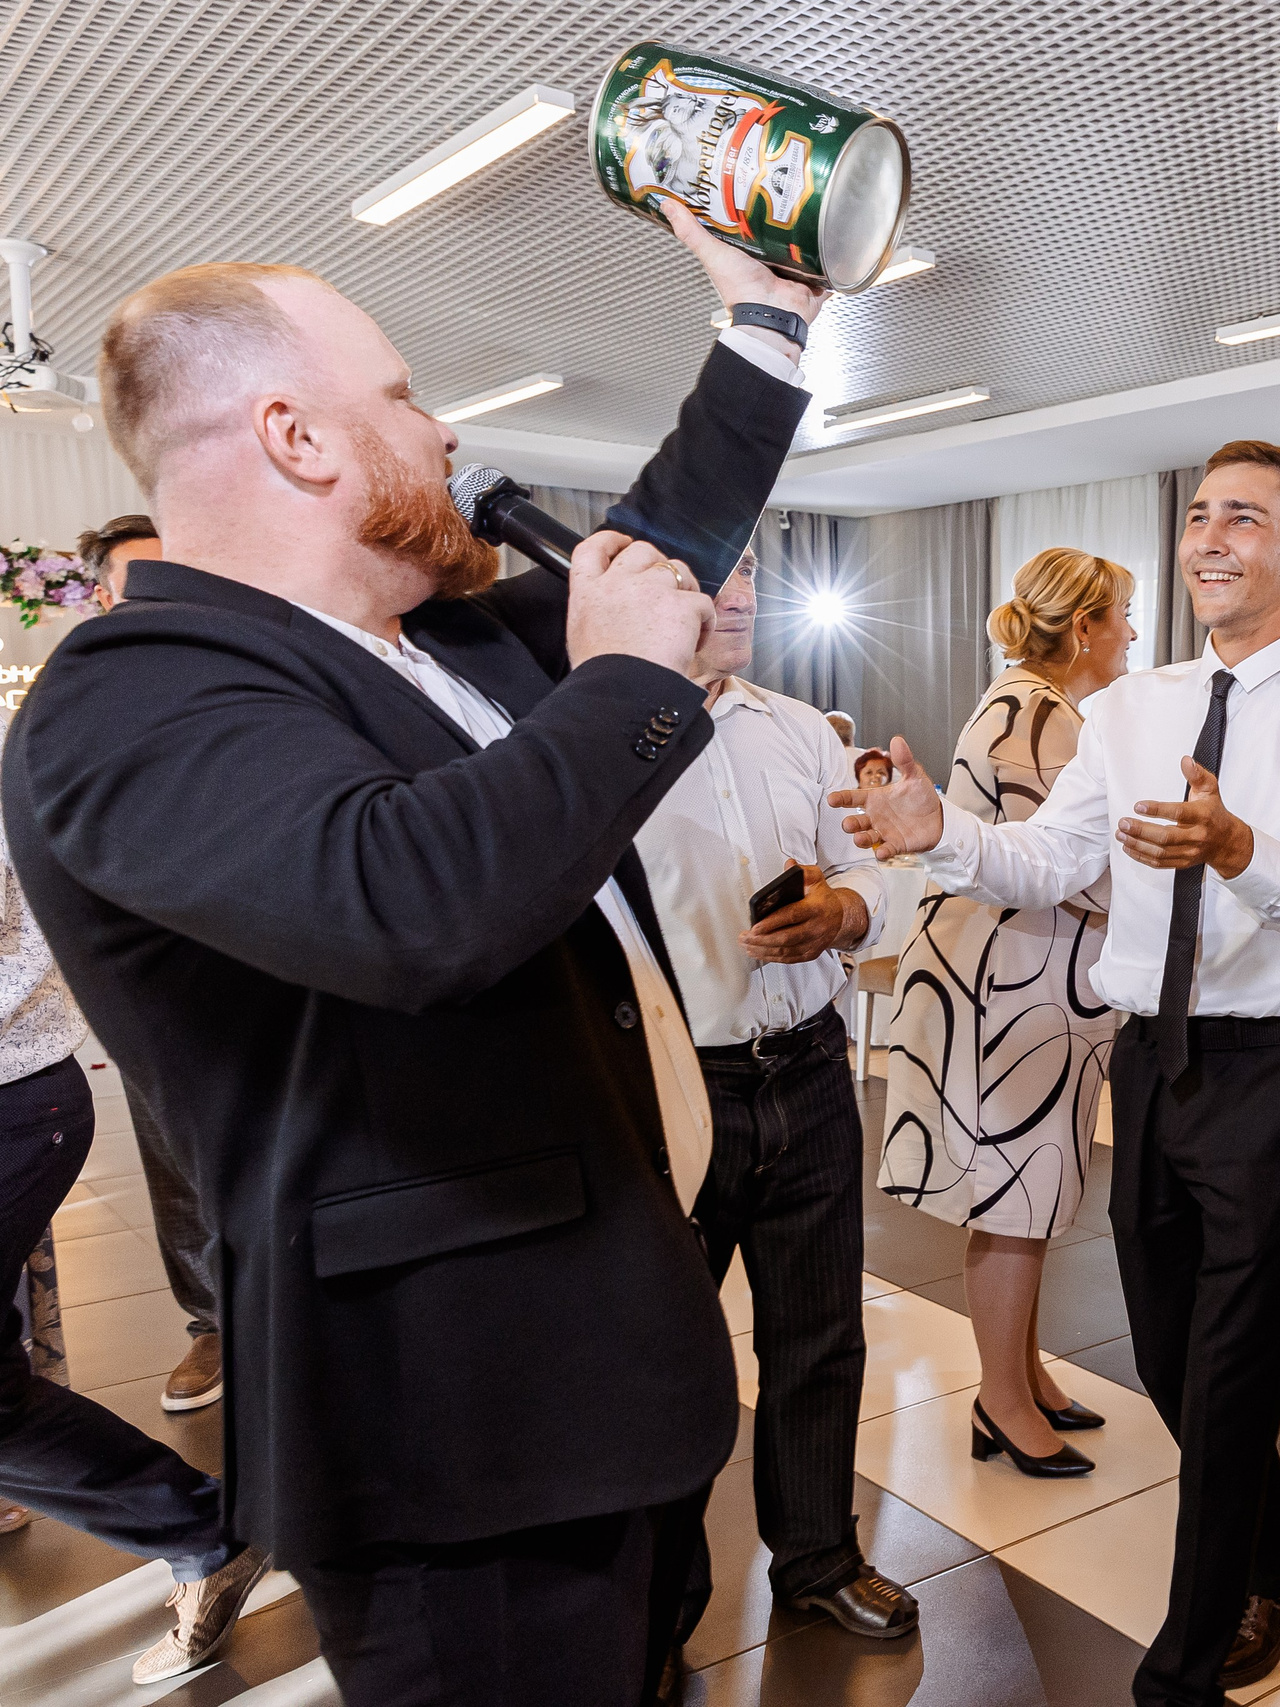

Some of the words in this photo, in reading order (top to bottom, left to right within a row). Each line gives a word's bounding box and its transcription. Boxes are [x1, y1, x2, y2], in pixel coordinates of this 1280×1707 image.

[614, 83, 639, 104] STANDARD
[723, 146, 739, 175] Lager
[742, 146, 754, 167] 1878
[791, 142, 800, 163] GEBRAUT
[737, 167, 748, 187] Seit
